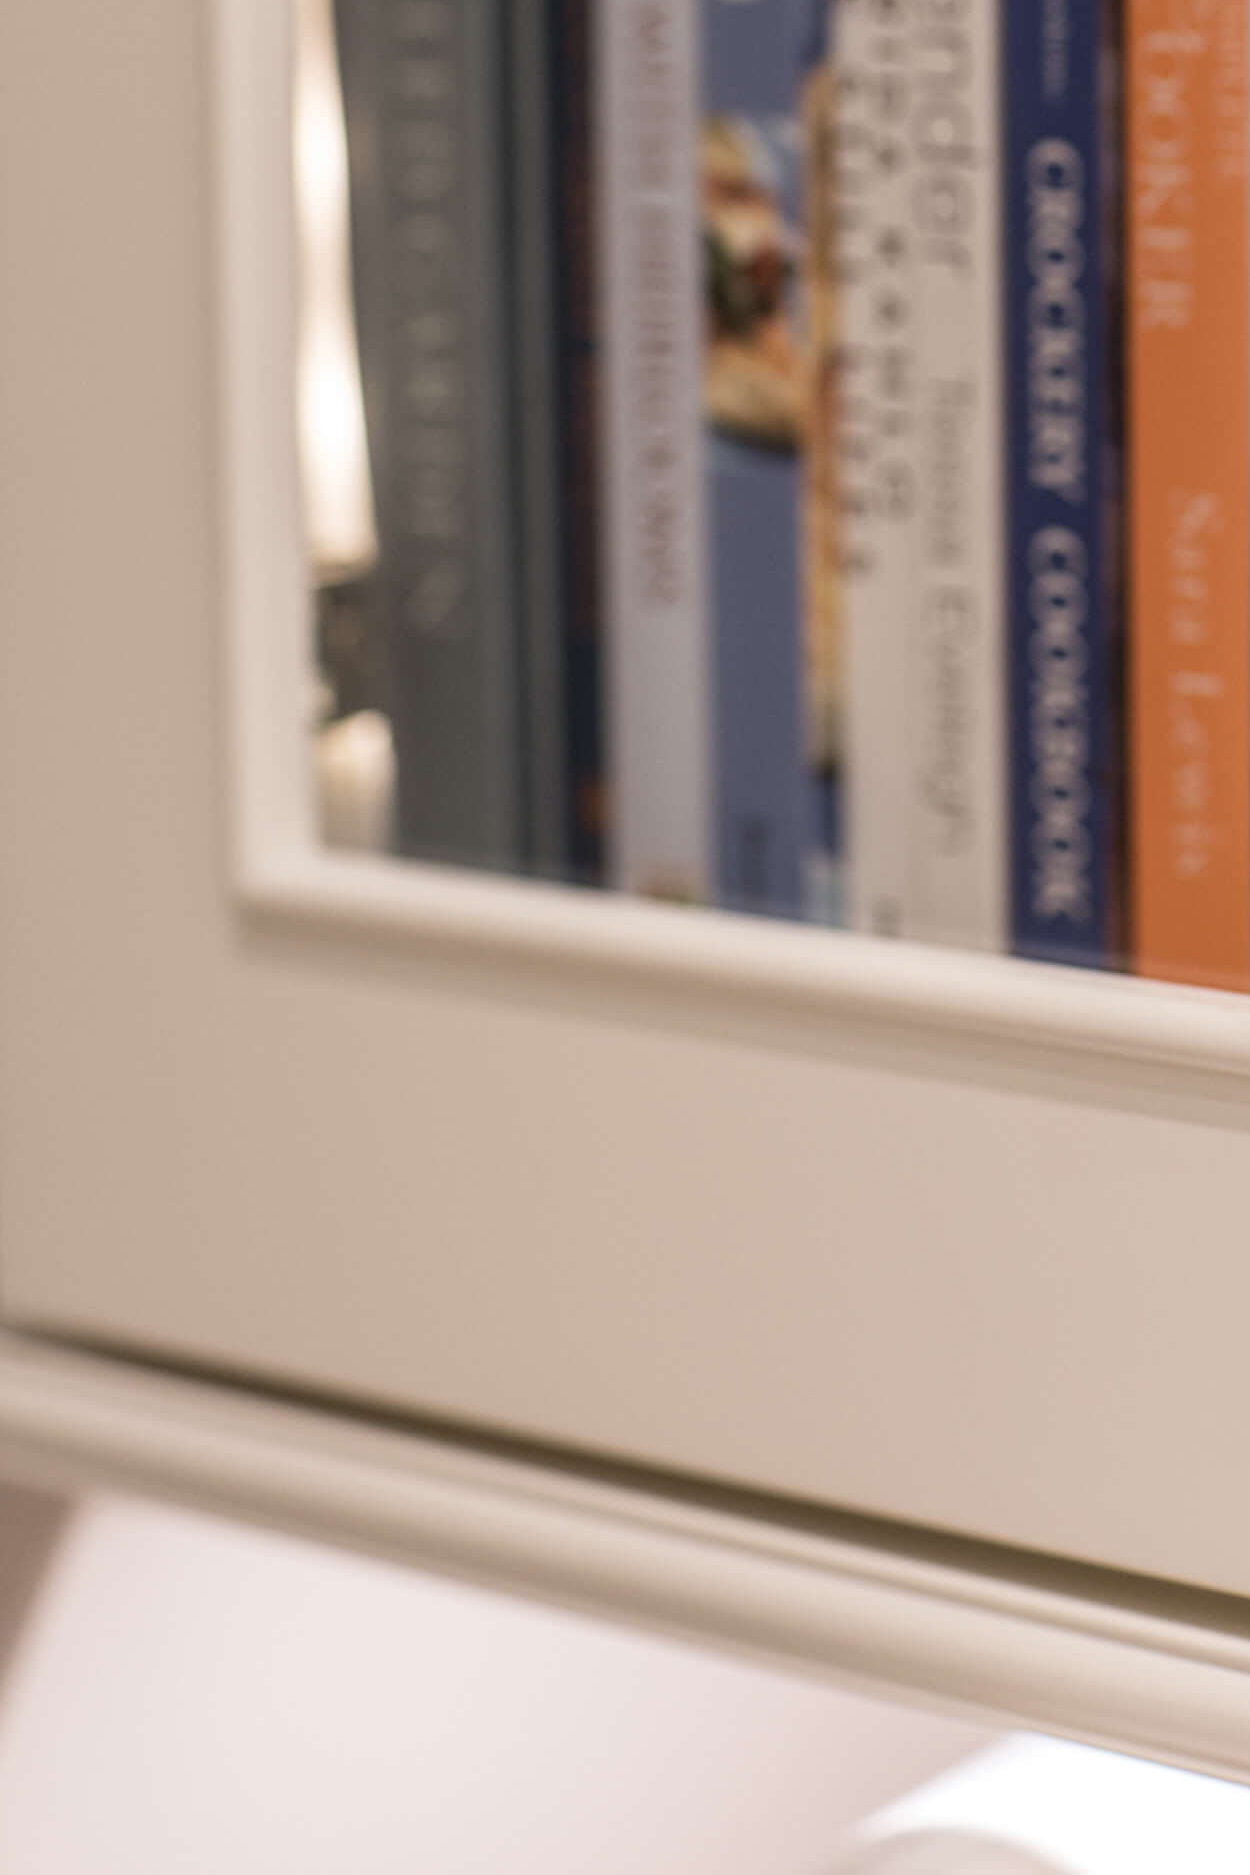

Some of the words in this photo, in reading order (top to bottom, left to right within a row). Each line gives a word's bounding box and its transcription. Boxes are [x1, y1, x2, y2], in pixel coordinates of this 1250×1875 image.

[1025, 135, 1089, 503] CROCKERY
[1168, 487, 1221, 647] Sara
[1027, 525, 1092, 921] COOKBOOK
[1170, 669, 1225, 877] Lewis
